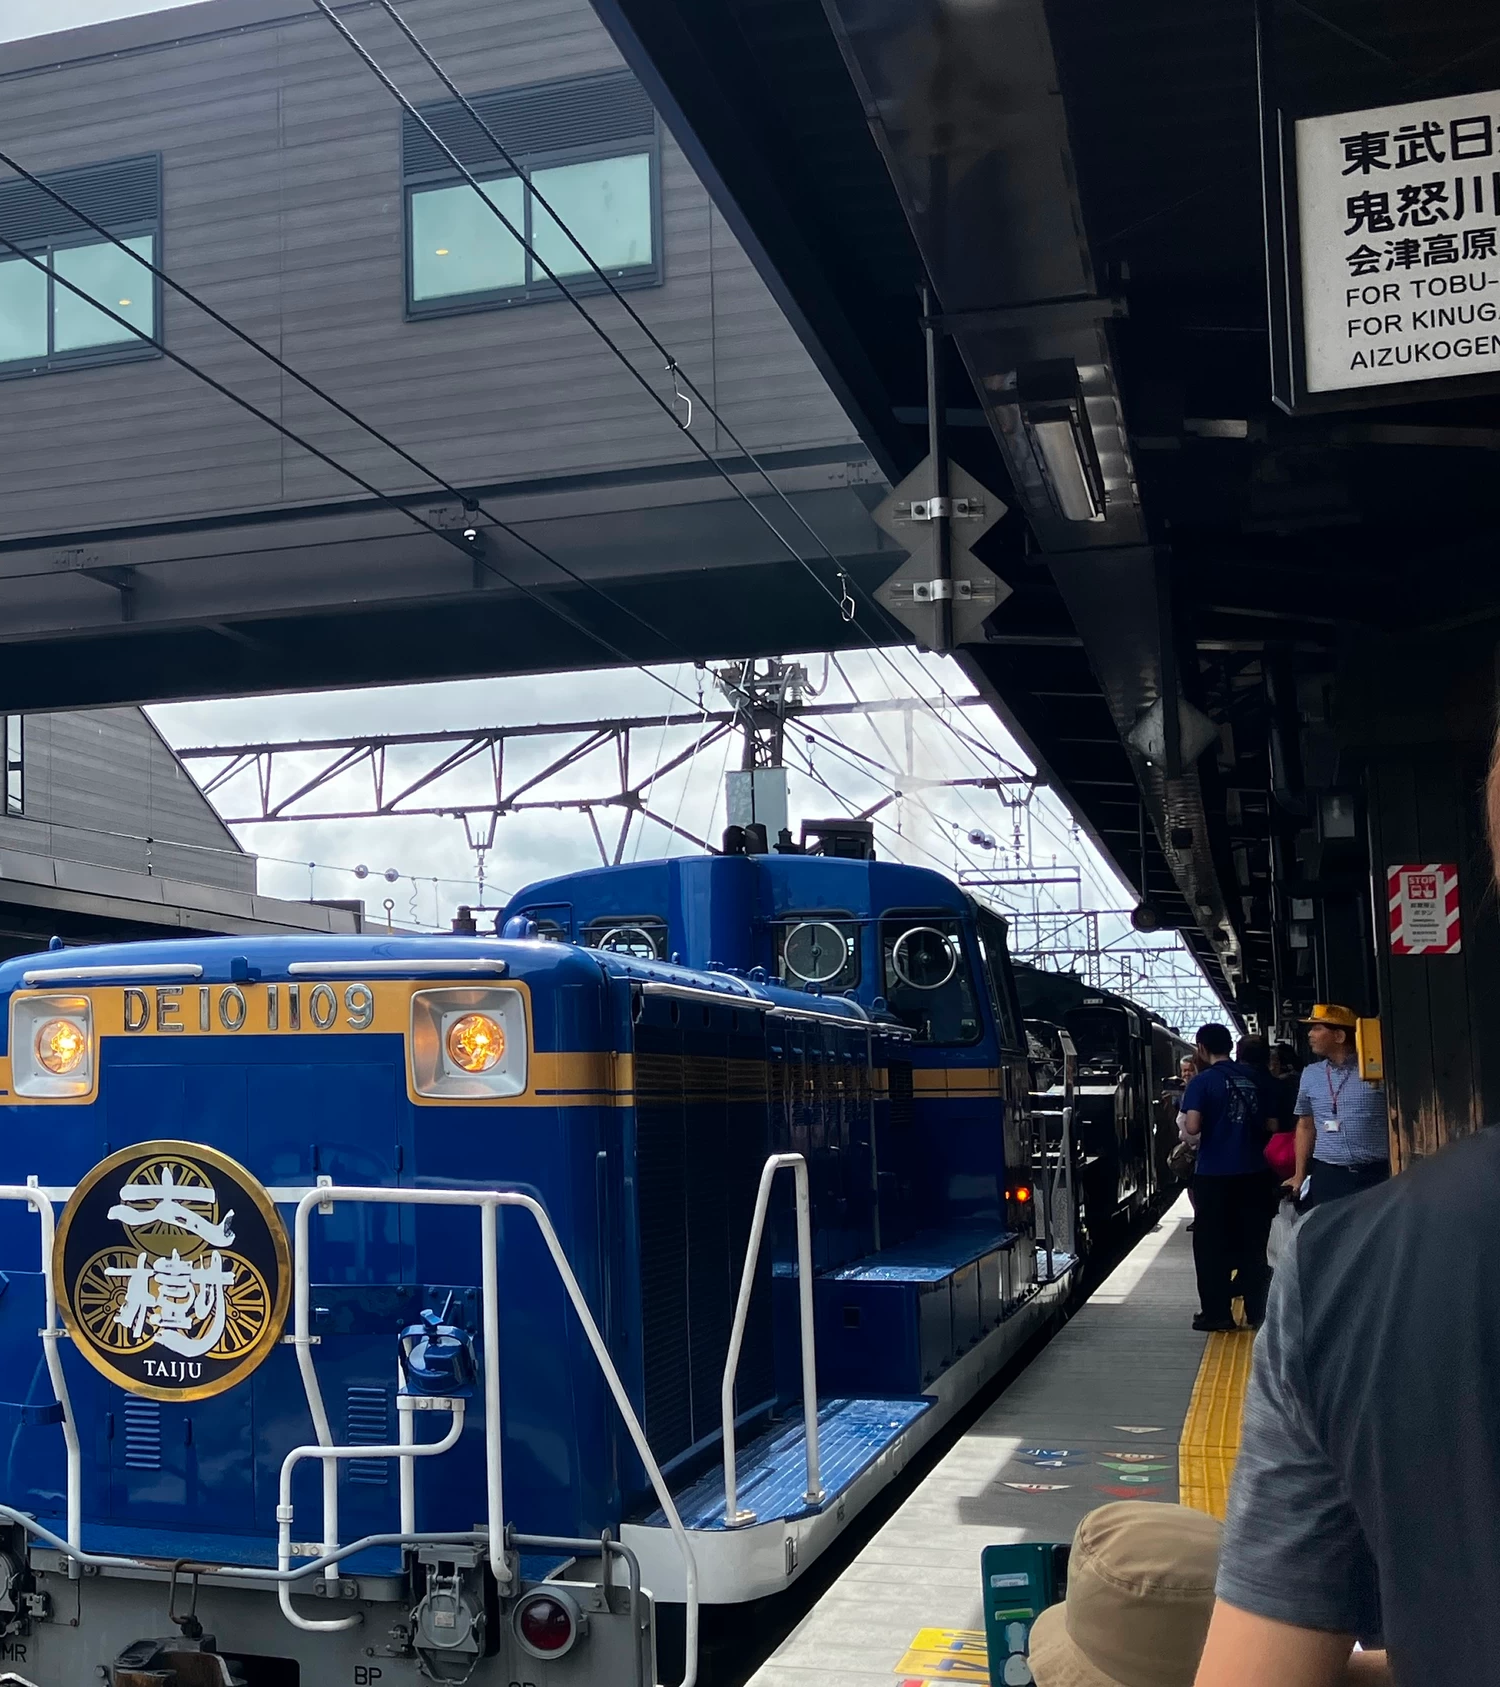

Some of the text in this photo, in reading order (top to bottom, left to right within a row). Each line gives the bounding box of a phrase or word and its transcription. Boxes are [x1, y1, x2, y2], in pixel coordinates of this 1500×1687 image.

[1339, 115, 1500, 176] 東武日
[1344, 171, 1500, 236] 鬼怒川
[1345, 226, 1498, 277] 会津高原
[1346, 283, 1401, 308] FOR
[1347, 302, 1500, 338] FOR KINUG
[1408, 876, 1436, 885] STOP
[266, 983, 374, 1031] 1109
[143, 1359, 203, 1382] TAIJU
[2, 1643, 27, 1663] MR
[354, 1665, 383, 1686] BP
